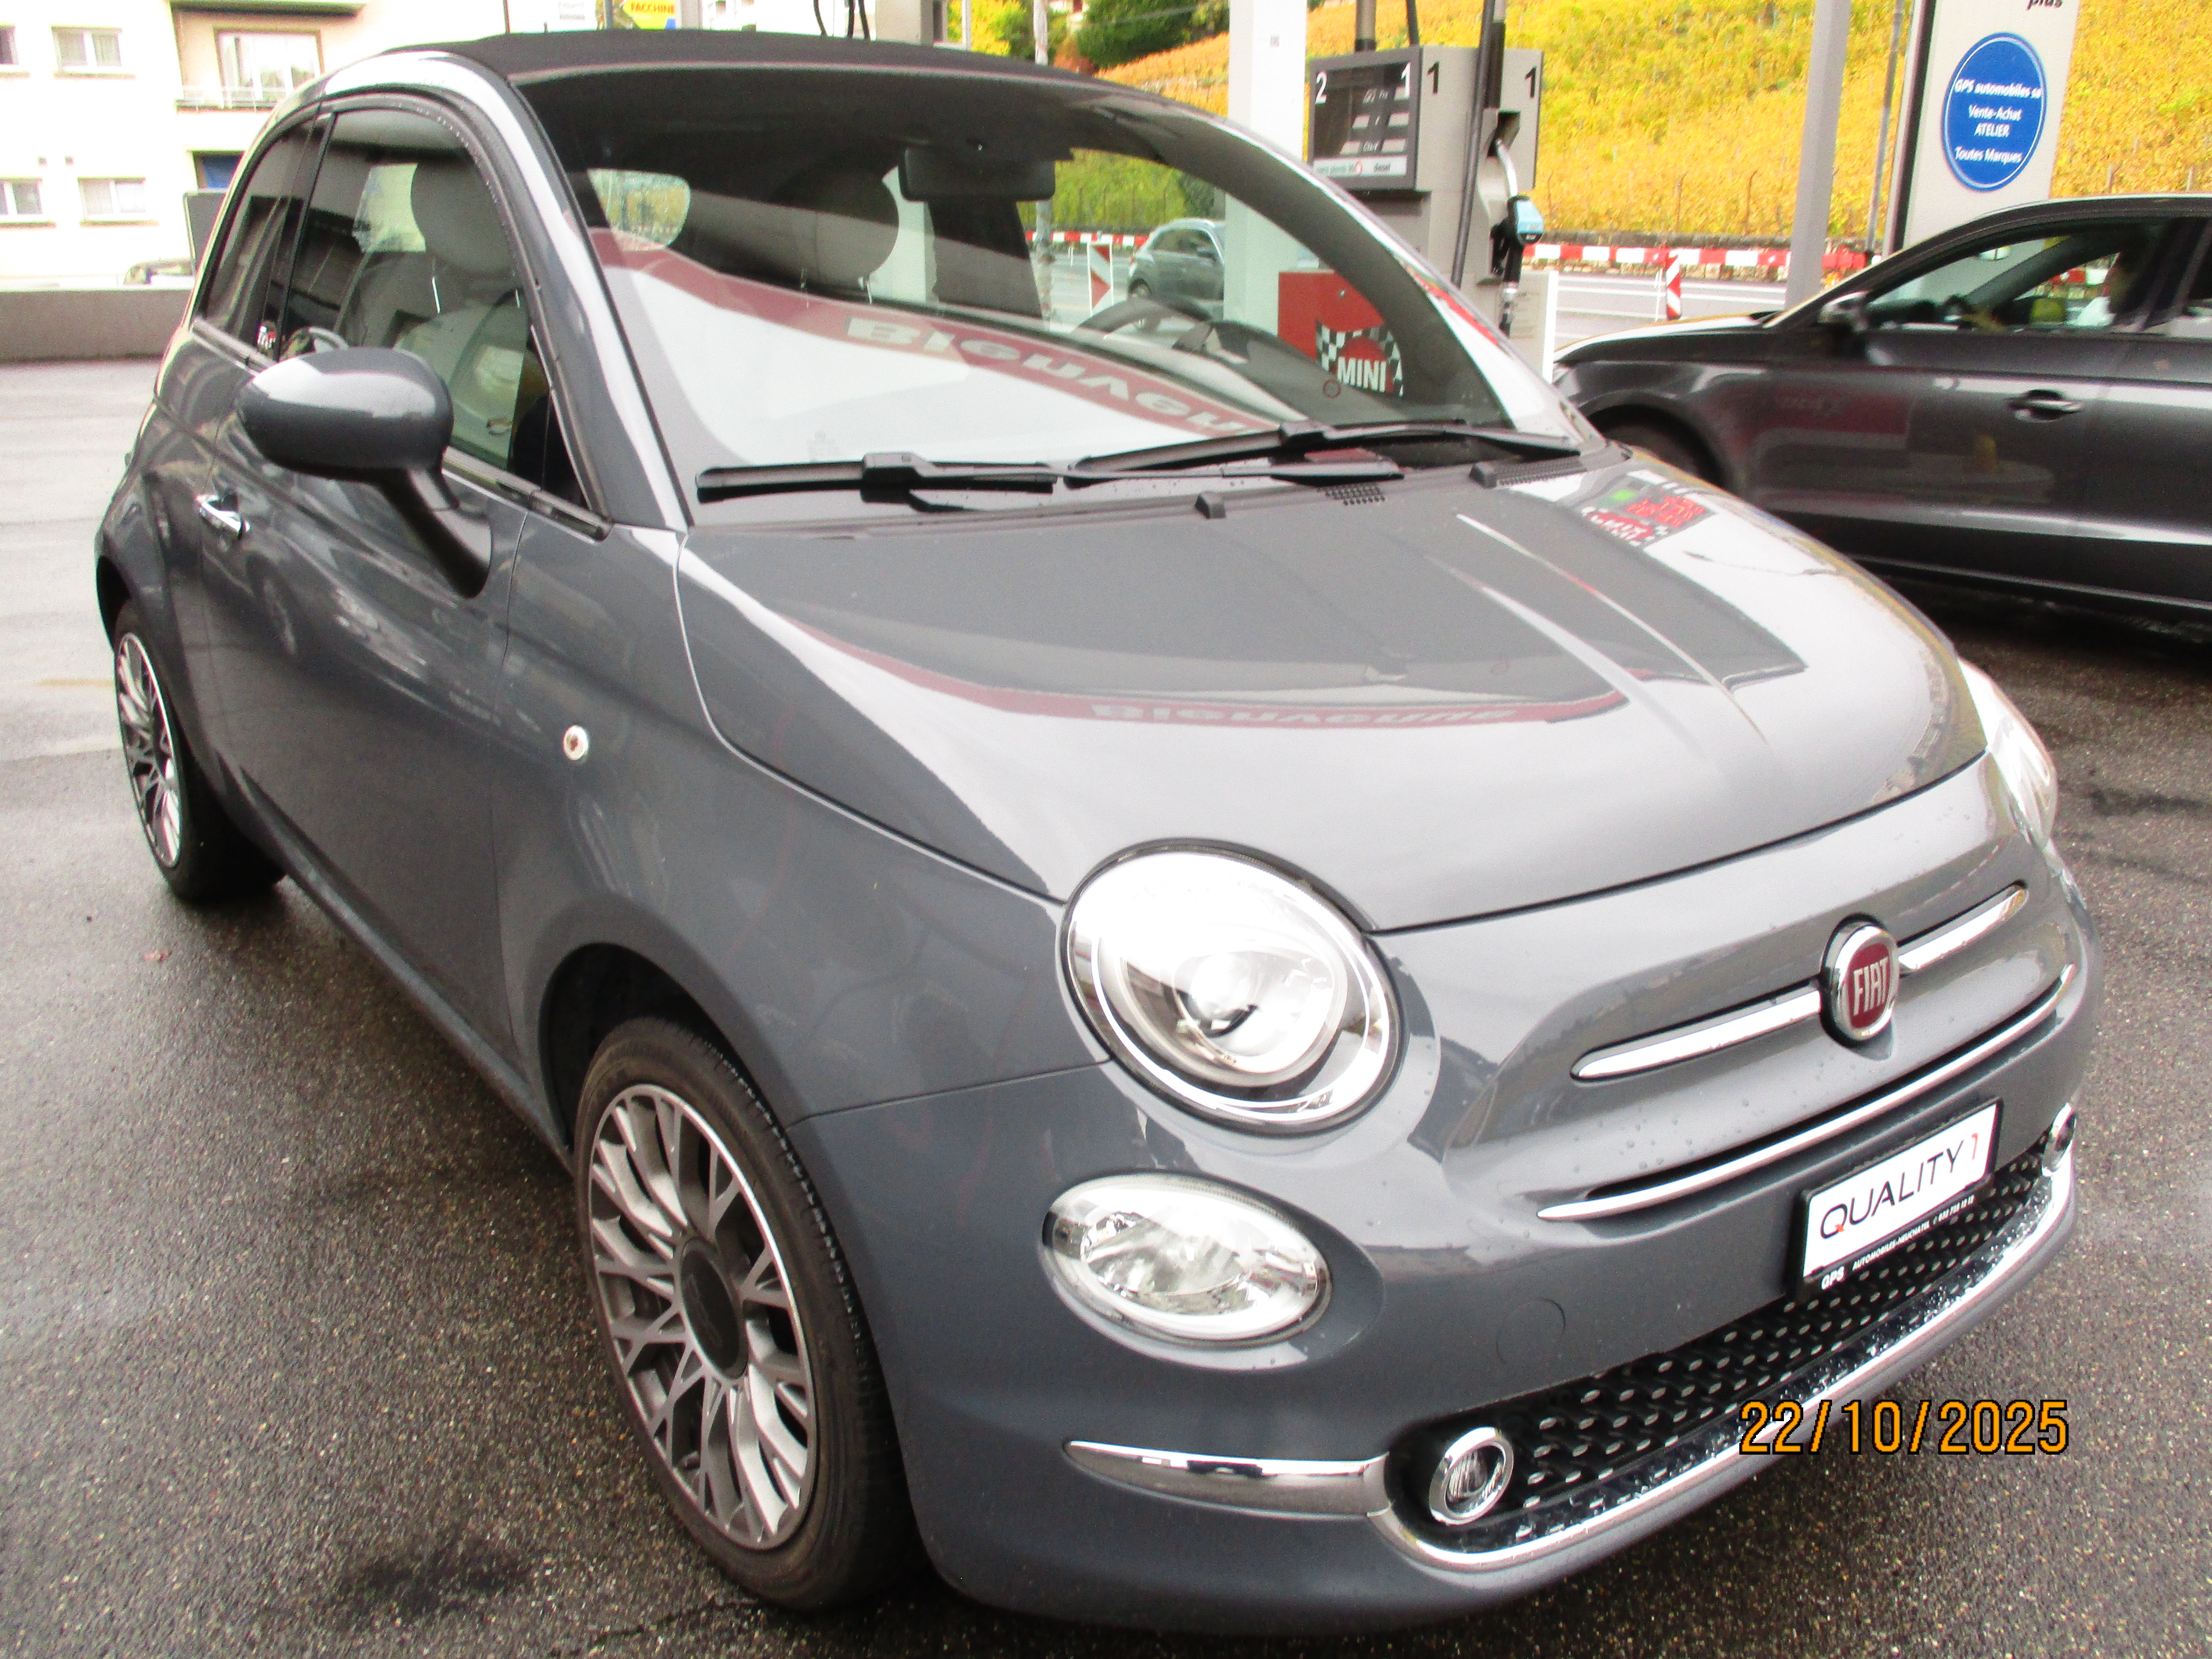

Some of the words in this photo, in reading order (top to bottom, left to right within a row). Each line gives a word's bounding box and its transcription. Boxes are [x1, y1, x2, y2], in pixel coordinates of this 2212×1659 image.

[1315, 71, 1328, 105] 2
[1400, 61, 1411, 100] 1
[1428, 61, 1440, 94] 1
[1525, 66, 1537, 98] 1
[1954, 79, 1975, 93] GPS
[1974, 82, 2031, 98] automobiles
[1968, 104, 2023, 122] Vente-Achat
[1974, 122, 2011, 138] ATELIER
[1954, 146, 1984, 161] Toutes
[1984, 148, 2023, 166] Marques
[1337, 356, 1386, 393] MINI
[1853, 956, 1889, 1016] FIAT
[1820, 1140, 1964, 1240] QUALITY
[1821, 1265, 1845, 1291] GPS
